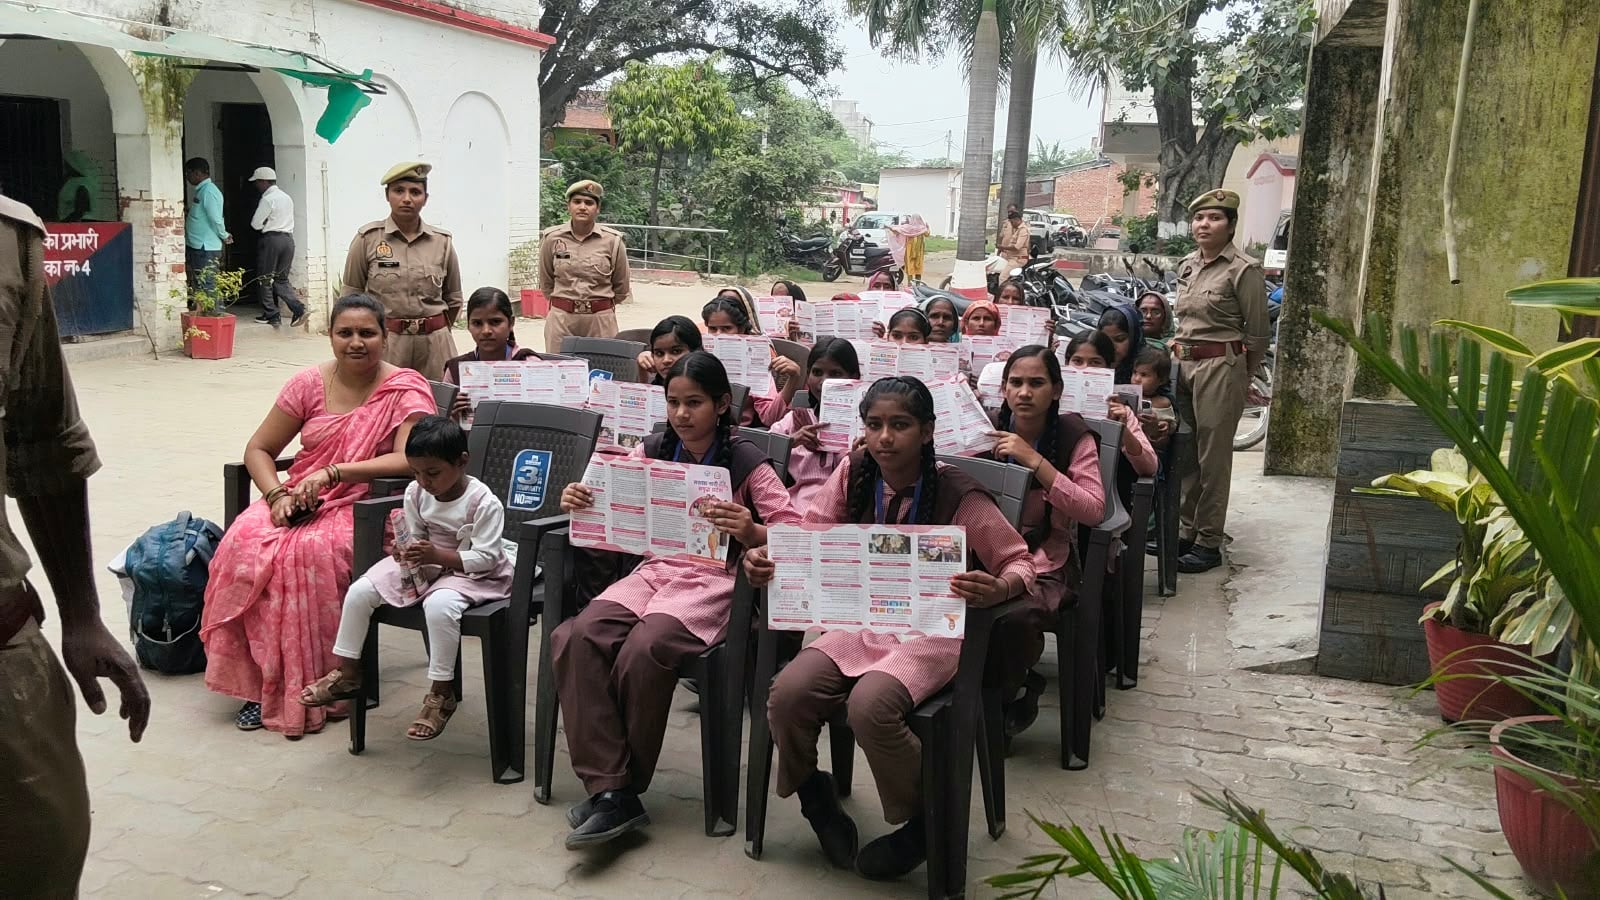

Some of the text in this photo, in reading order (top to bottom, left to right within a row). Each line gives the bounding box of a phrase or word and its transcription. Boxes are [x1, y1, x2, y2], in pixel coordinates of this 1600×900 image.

[60, 228, 99, 251] प्रभारी
[517, 466, 539, 485] 3
[514, 493, 525, 504] NO
